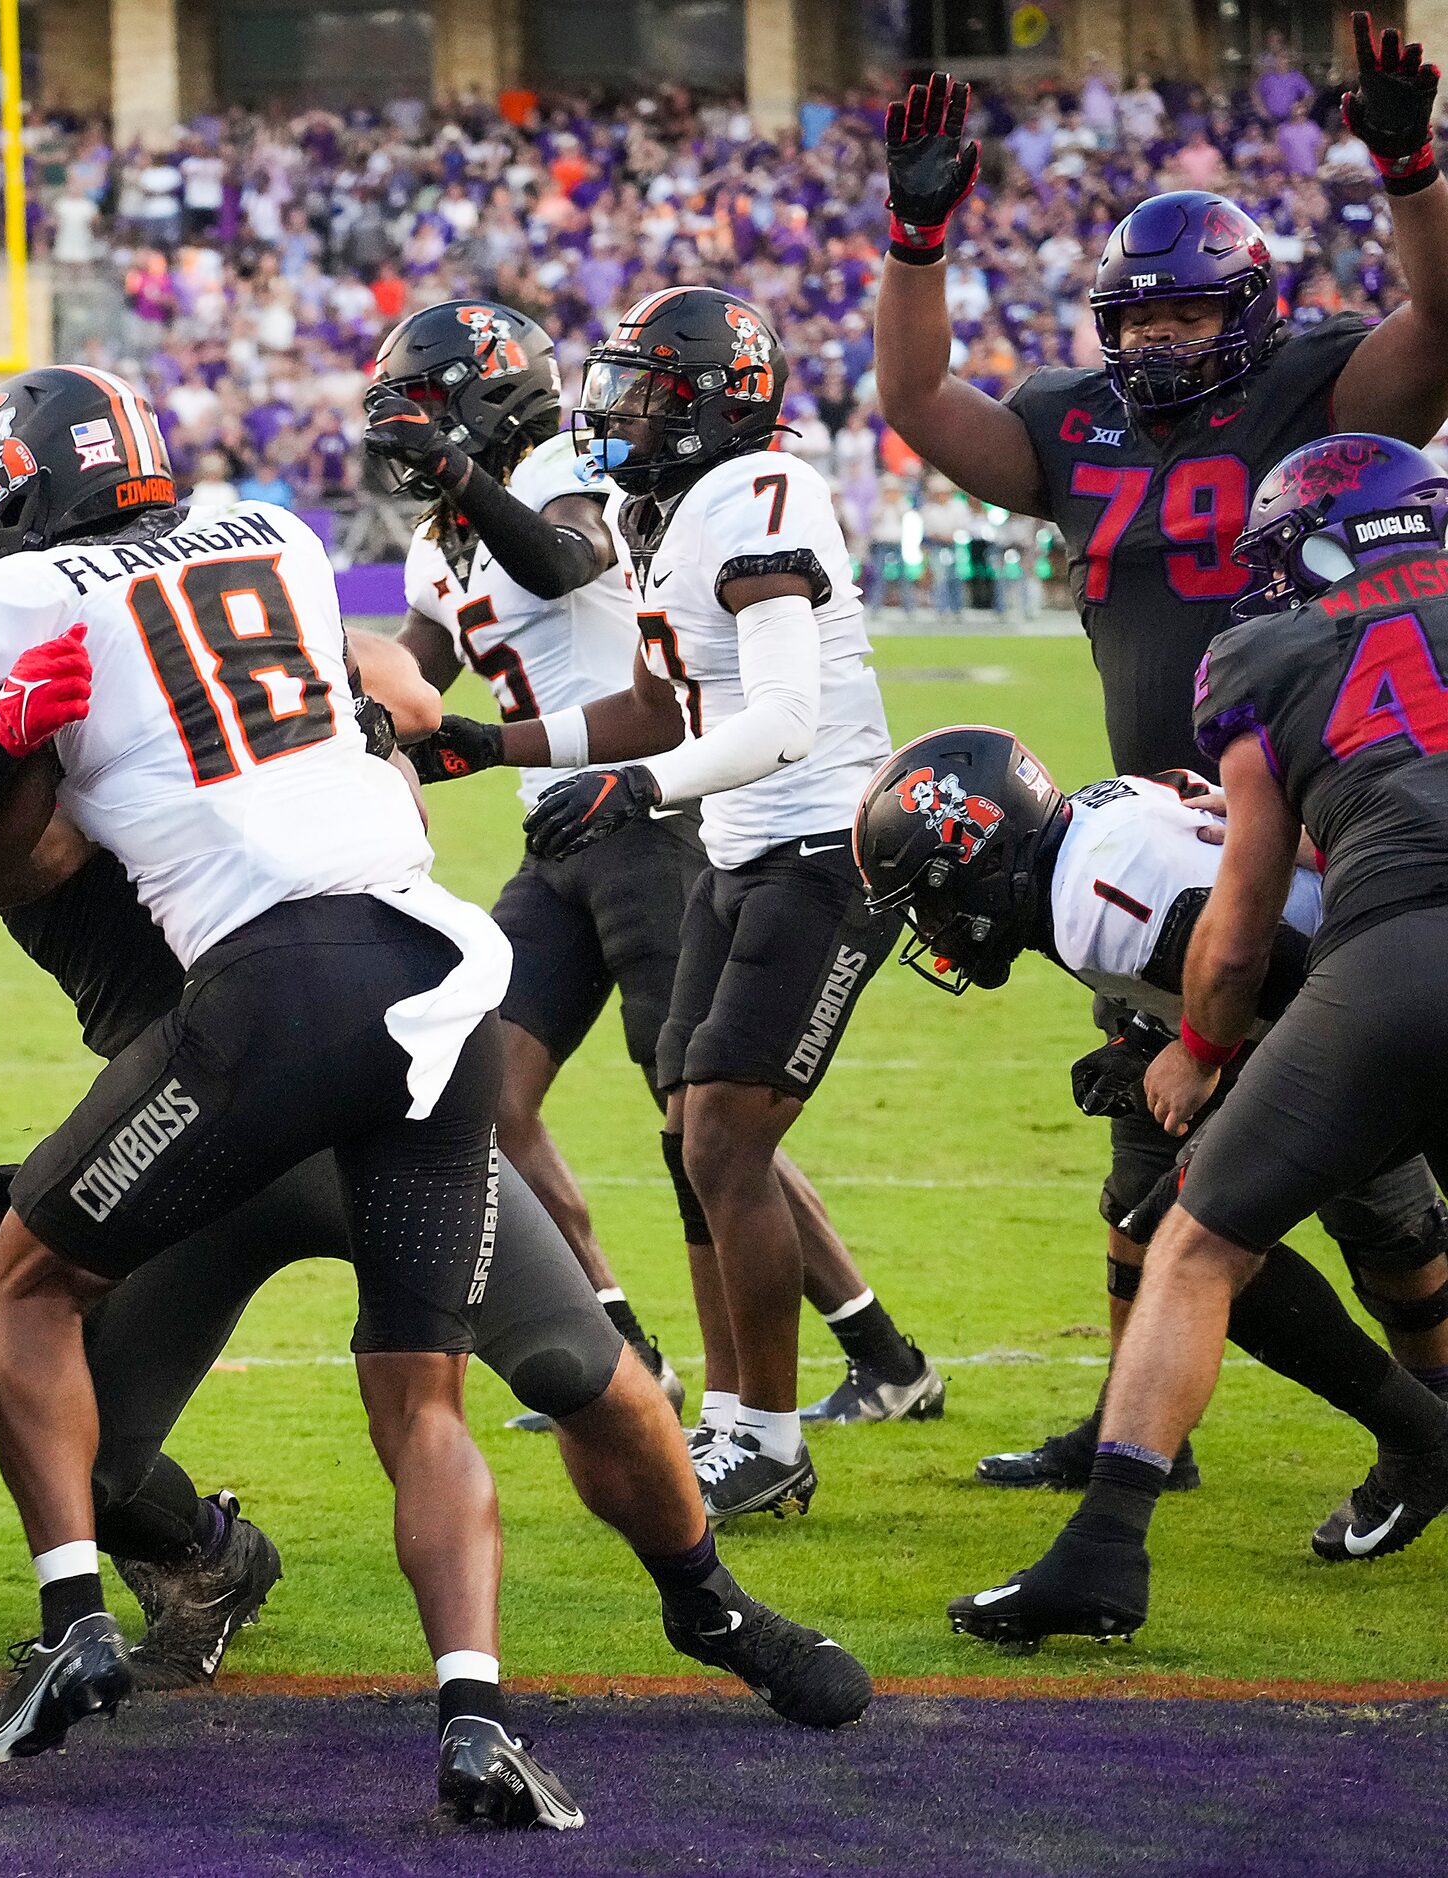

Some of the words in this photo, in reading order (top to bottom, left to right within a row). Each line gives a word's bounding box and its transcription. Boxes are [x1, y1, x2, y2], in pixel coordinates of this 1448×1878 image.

[1129, 273, 1158, 288] TCU
[1058, 407, 1093, 444] C
[1086, 426, 1126, 448] XII
[753, 473, 789, 536] 7
[1070, 453, 1251, 602] 79
[52, 512, 287, 597] FLANAGAN
[125, 552, 337, 788] 18
[1093, 879, 1153, 924] 1
[783, 944, 869, 1084] COWBOYS
[69, 1077, 201, 1223] COWBOYS
